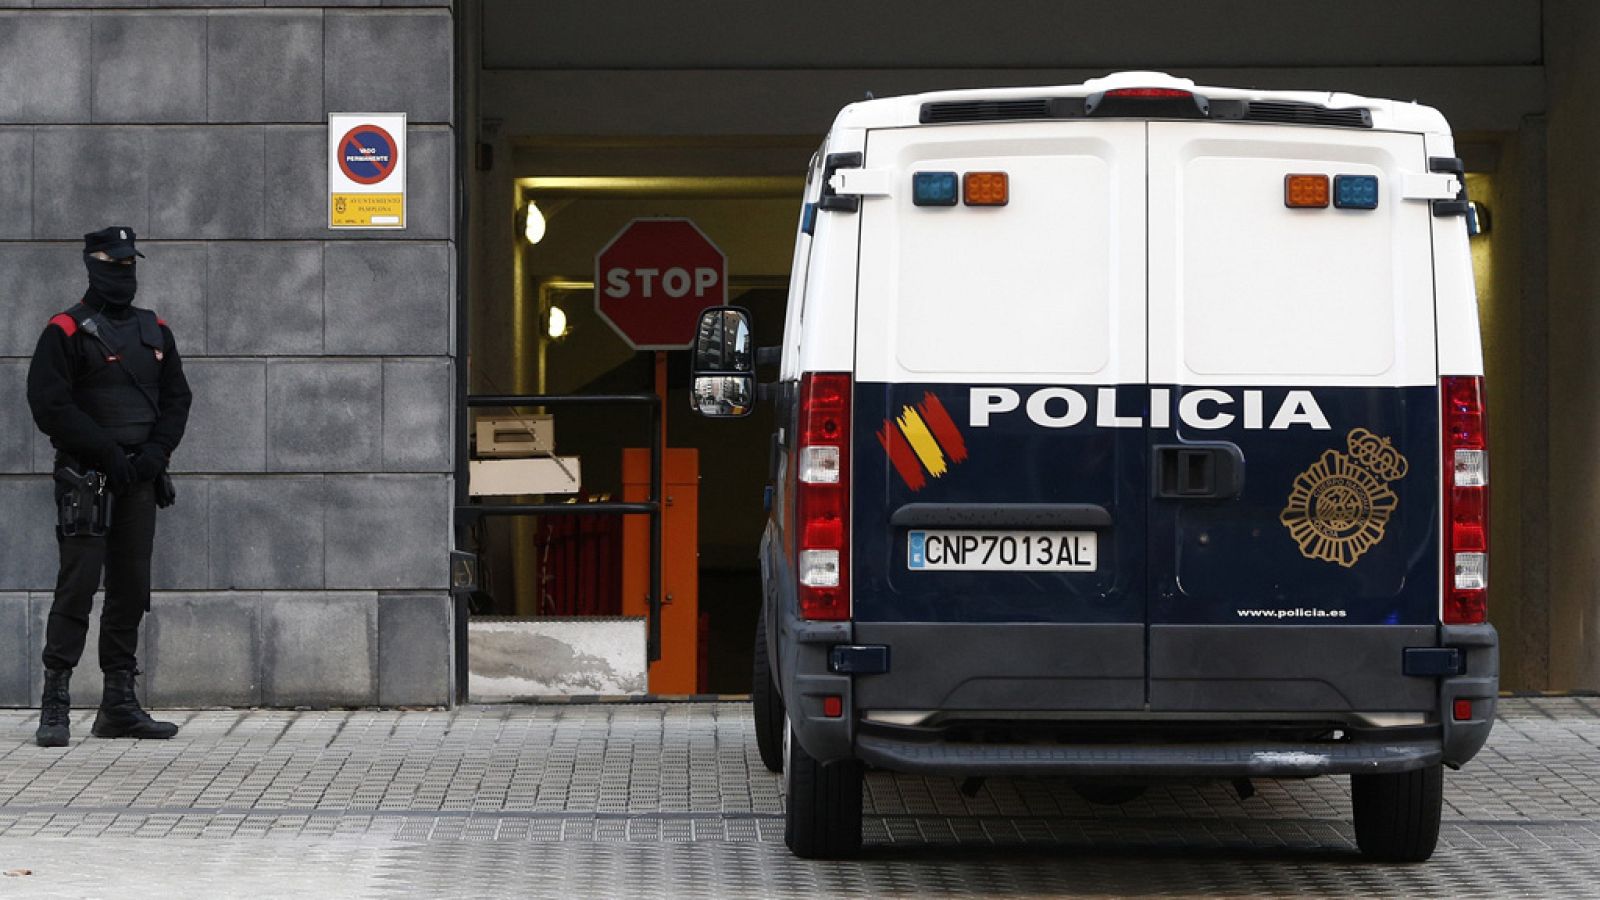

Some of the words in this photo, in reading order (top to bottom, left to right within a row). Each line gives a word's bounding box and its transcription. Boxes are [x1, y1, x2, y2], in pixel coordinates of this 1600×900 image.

[604, 266, 719, 298] STOP
[968, 387, 1332, 431] POLICIA
[925, 535, 1092, 566] CNP7013AL
[1237, 607, 1348, 620] www.policia.es
